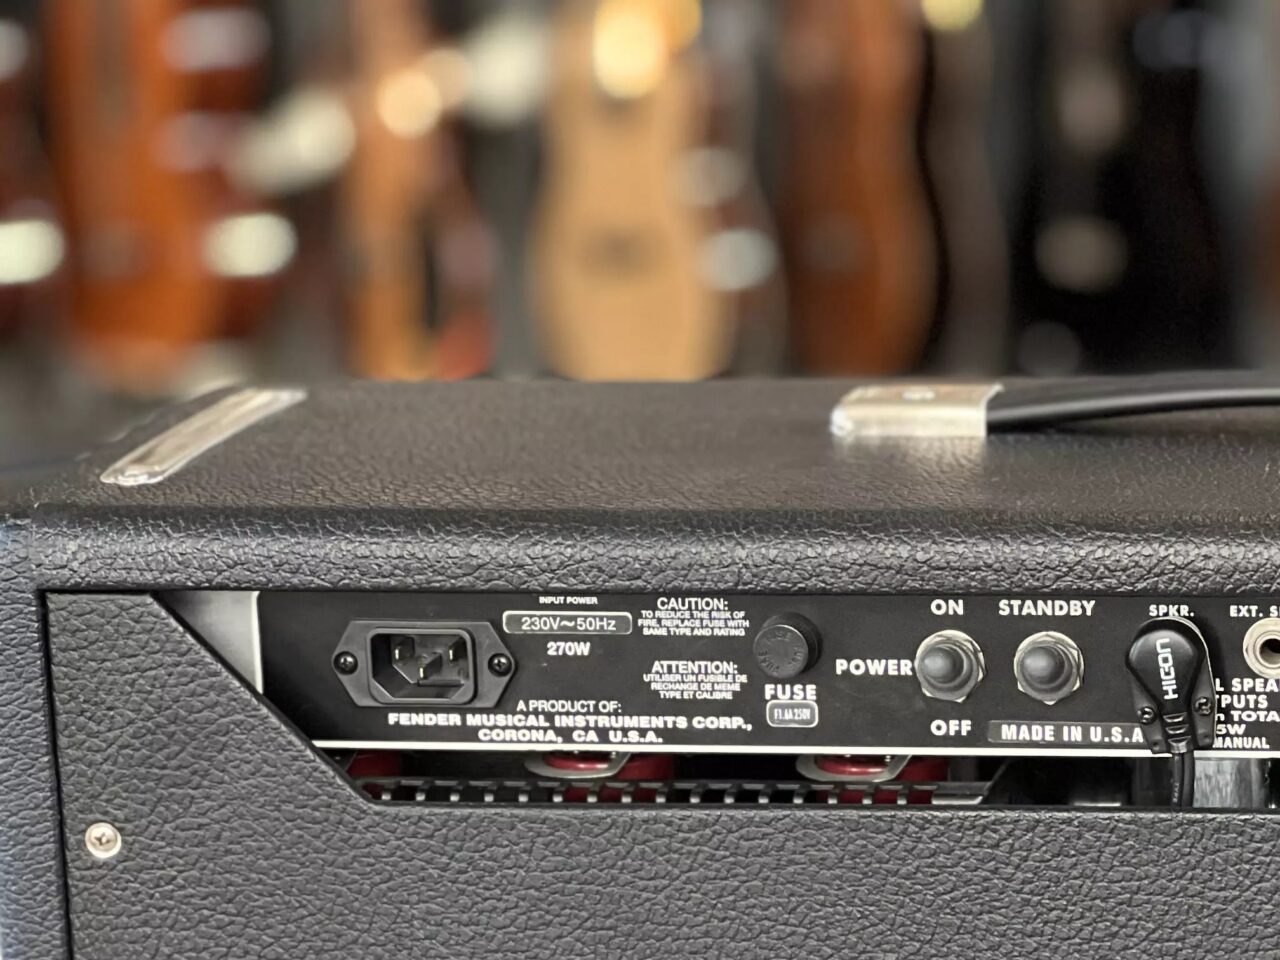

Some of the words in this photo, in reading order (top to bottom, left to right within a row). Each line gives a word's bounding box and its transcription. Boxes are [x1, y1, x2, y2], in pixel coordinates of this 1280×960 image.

[539, 596, 564, 605] INPUT
[566, 596, 598, 605] POWER
[657, 597, 729, 610] CAUTION:
[930, 599, 964, 616] ON
[998, 600, 1096, 617] STANDBY
[1149, 604, 1195, 617] SPKR.
[1229, 605, 1263, 618] EXT.
[641, 610, 654, 619] TO
[655, 610, 690, 619] REDUCE
[693, 610, 710, 619] THE
[711, 610, 732, 619] RISK
[733, 610, 746, 619] OF
[638, 619, 660, 628] FIRE,
[661, 619, 701, 628] REPLACE
[703, 619, 726, 628] FUSE
[727, 619, 750, 628] WITH
[642, 628, 668, 636] SAME
[669, 628, 692, 636] TYPE
[693, 628, 712, 636] AND
[713, 628, 746, 636] RATING
[547, 641, 591, 656] 270W
[652, 660, 738, 673] ATTENTION:
[835, 658, 913, 676] POWER
[1156, 638, 1179, 700] HICON
[643, 674, 682, 683] UTILISER
[683, 674, 697, 683] UN
[698, 674, 733, 683] FUSIBLE
[735, 674, 748, 683] DE
[651, 683, 699, 691] RECHANGE
[701, 683, 712, 691] DE
[714, 683, 741, 691] MEME
[764, 684, 817, 700] FUSE
[659, 691, 682, 700] TYPE
[683, 691, 695, 700] ET
[696, 691, 733, 700] CALIBRE
[1215, 694, 1268, 709] PUTS
[516, 700, 527, 712] A
[529, 700, 596, 712] PRODUCT
[599, 700, 622, 712] OF:
[388, 713, 462, 726] FENDER
[466, 713, 550, 727] MUSICAL
[554, 714, 688, 729] INSTRUMENTS
[692, 716, 752, 731] CORP.,
[930, 719, 972, 737] OFF
[478, 728, 563, 743] CORONA,
[572, 730, 599, 743] CA
[608, 730, 663, 743] U.S.A.
[1001, 724, 1055, 741] MADE
[1062, 725, 1083, 742] IN
[1216, 723, 1246, 735] 5W
[1212, 736, 1270, 749] MANUAL
